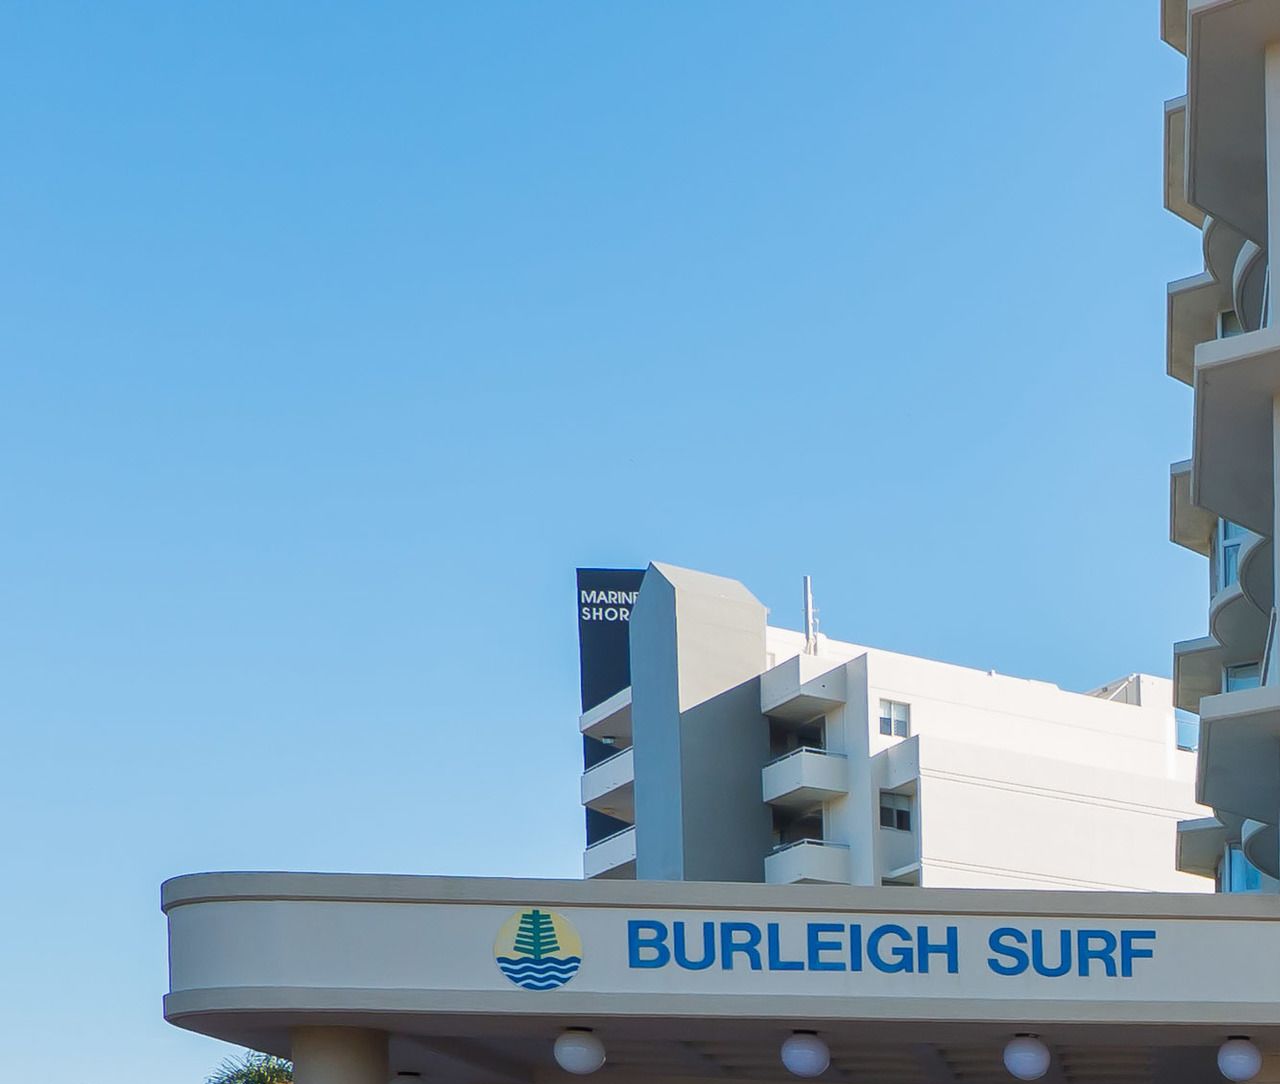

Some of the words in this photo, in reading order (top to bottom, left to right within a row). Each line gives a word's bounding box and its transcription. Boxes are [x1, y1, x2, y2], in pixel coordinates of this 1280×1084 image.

[582, 607, 629, 620] SHOR
[627, 919, 959, 974] BURLEIGH
[987, 927, 1157, 978] SURF
